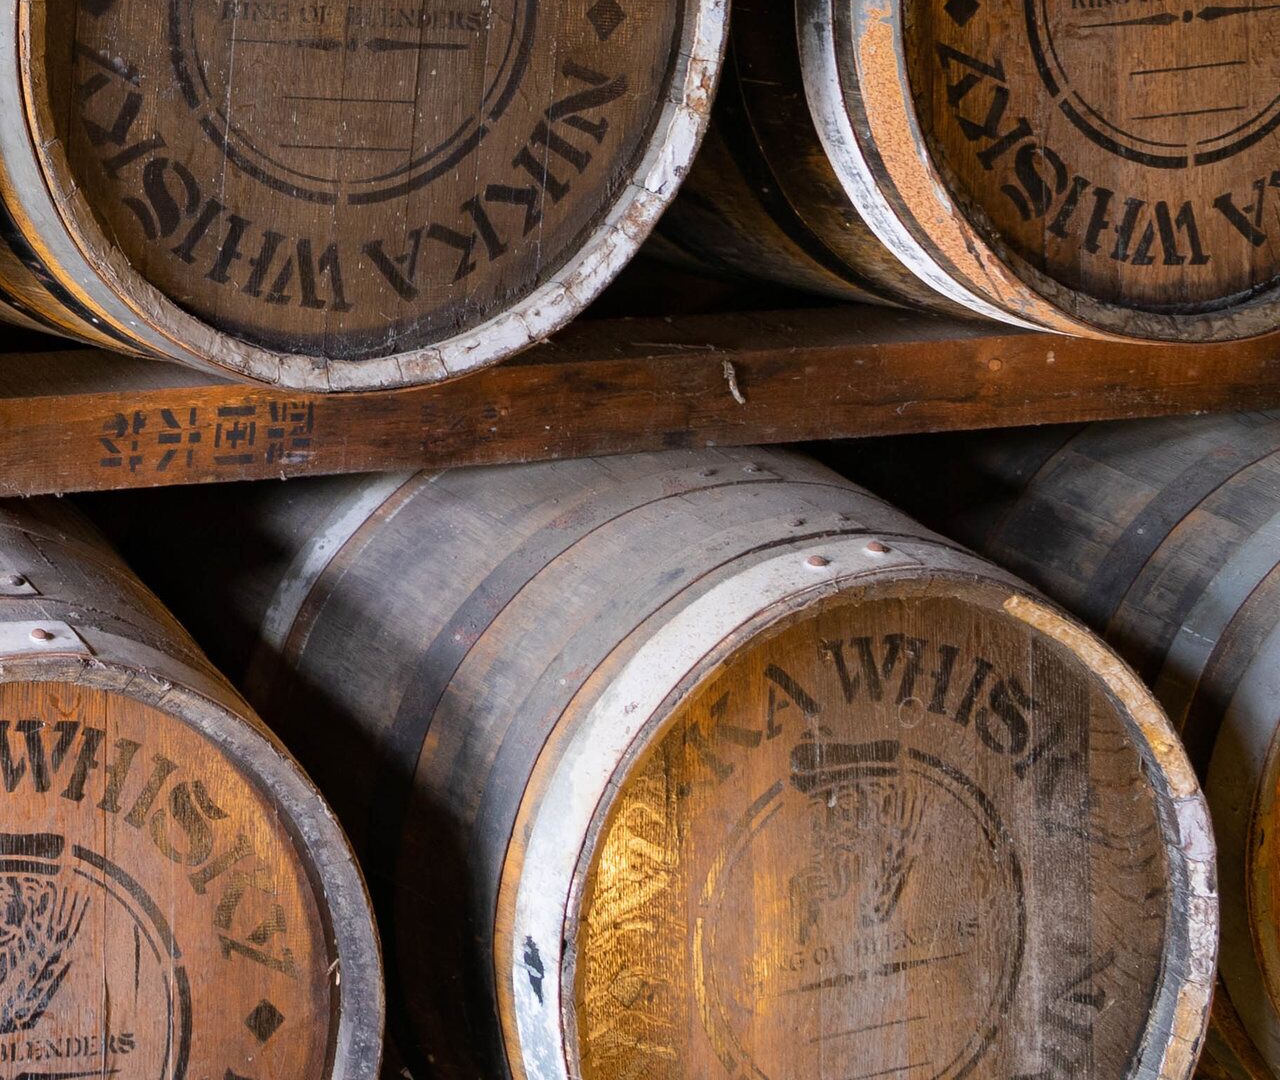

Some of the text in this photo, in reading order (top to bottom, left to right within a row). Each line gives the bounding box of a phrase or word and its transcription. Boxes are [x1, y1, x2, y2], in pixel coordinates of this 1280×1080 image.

[74, 40, 629, 313] NIKKA WHISKY
[941, 41, 1212, 266] WHISKY
